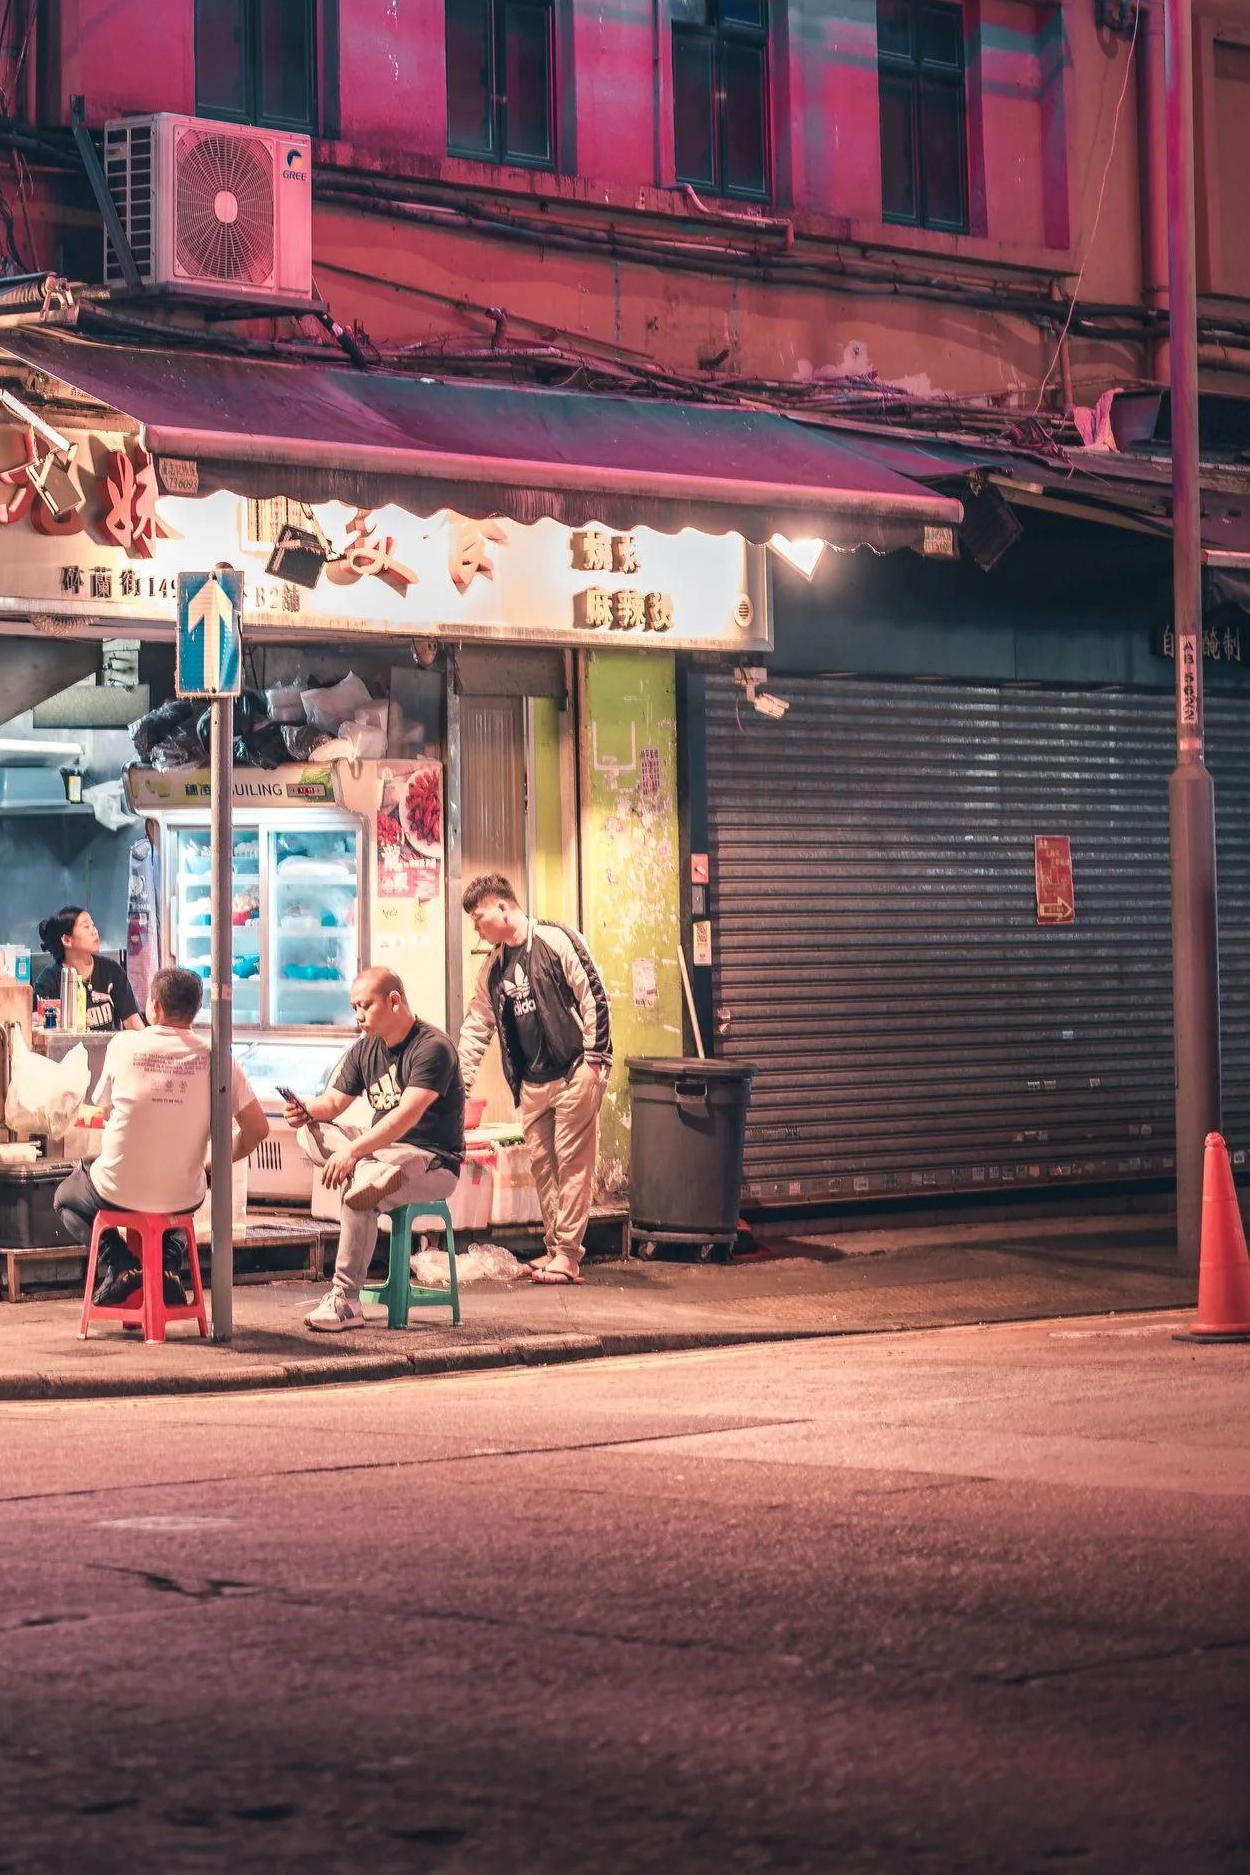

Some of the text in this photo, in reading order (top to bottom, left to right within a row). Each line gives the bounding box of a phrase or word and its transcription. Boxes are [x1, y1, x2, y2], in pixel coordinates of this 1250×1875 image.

[283, 170, 306, 181] GREE
[1183, 641, 1195, 721] AB 5622
[232, 783, 283, 796] UILING
